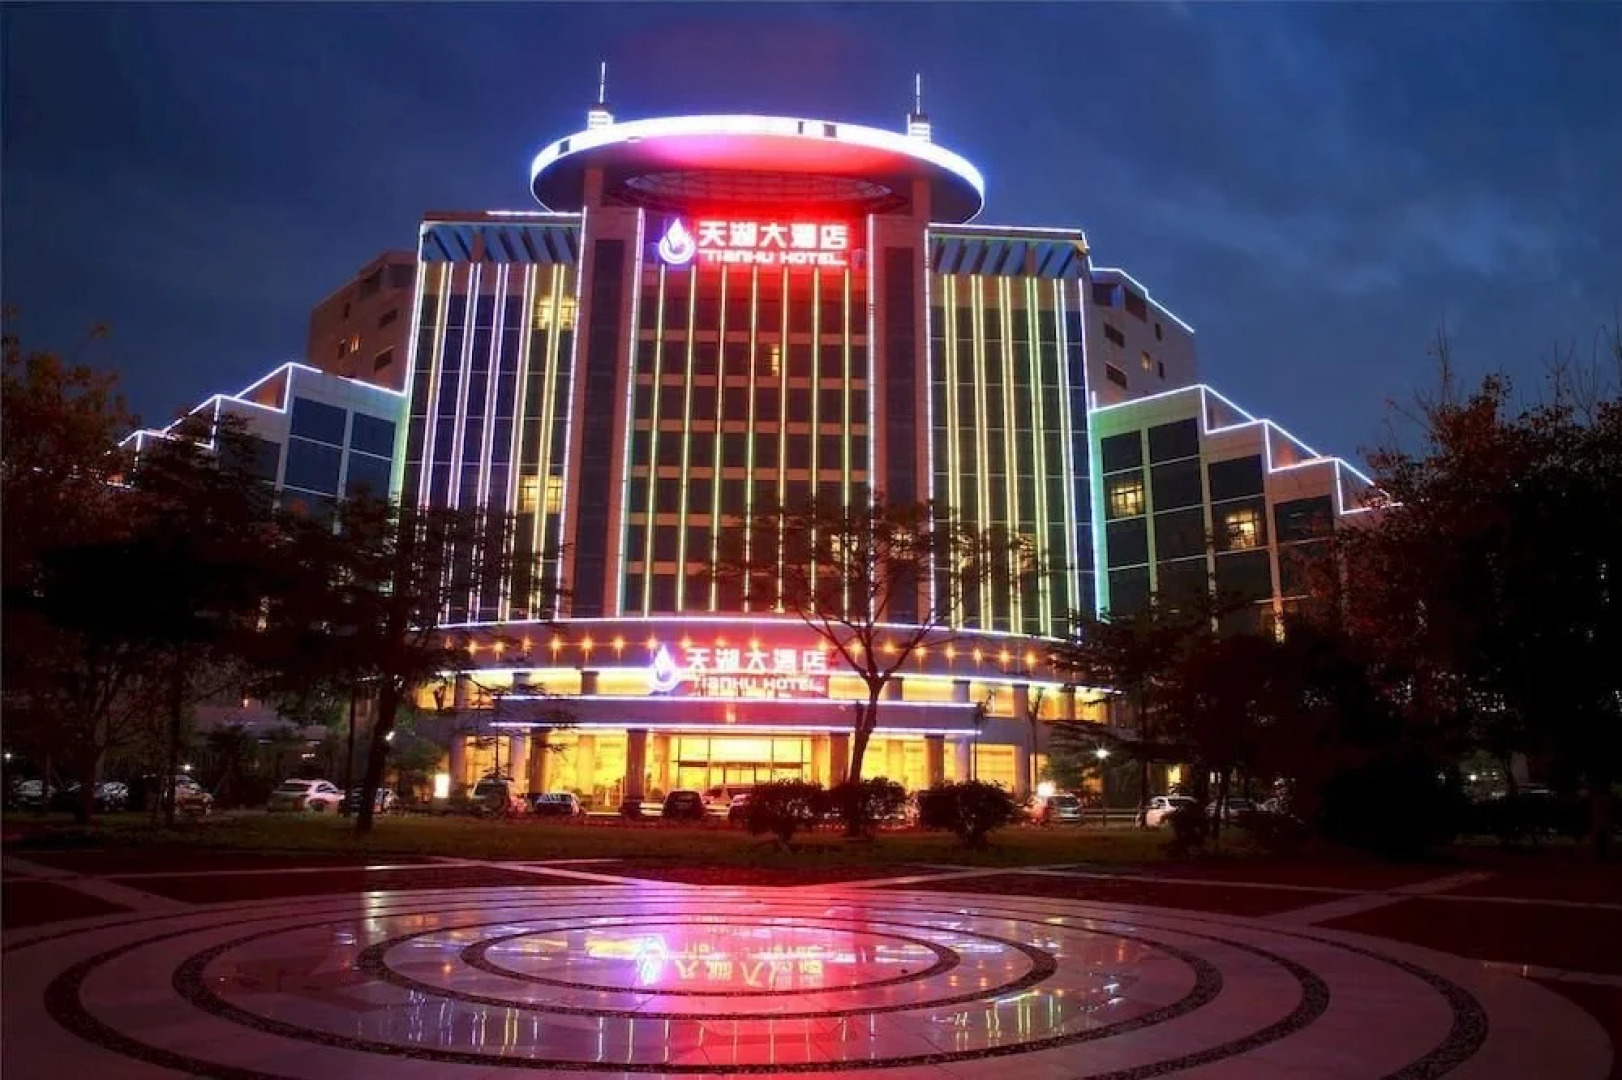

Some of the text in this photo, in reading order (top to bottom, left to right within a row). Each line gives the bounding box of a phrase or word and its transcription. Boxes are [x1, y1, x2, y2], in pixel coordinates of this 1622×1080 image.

[700, 220, 848, 250] 天湖大酒店
[779, 251, 848, 266] HOTEL
[686, 648, 829, 673] 天湖大酒店
[763, 677, 825, 693] HOTEL
